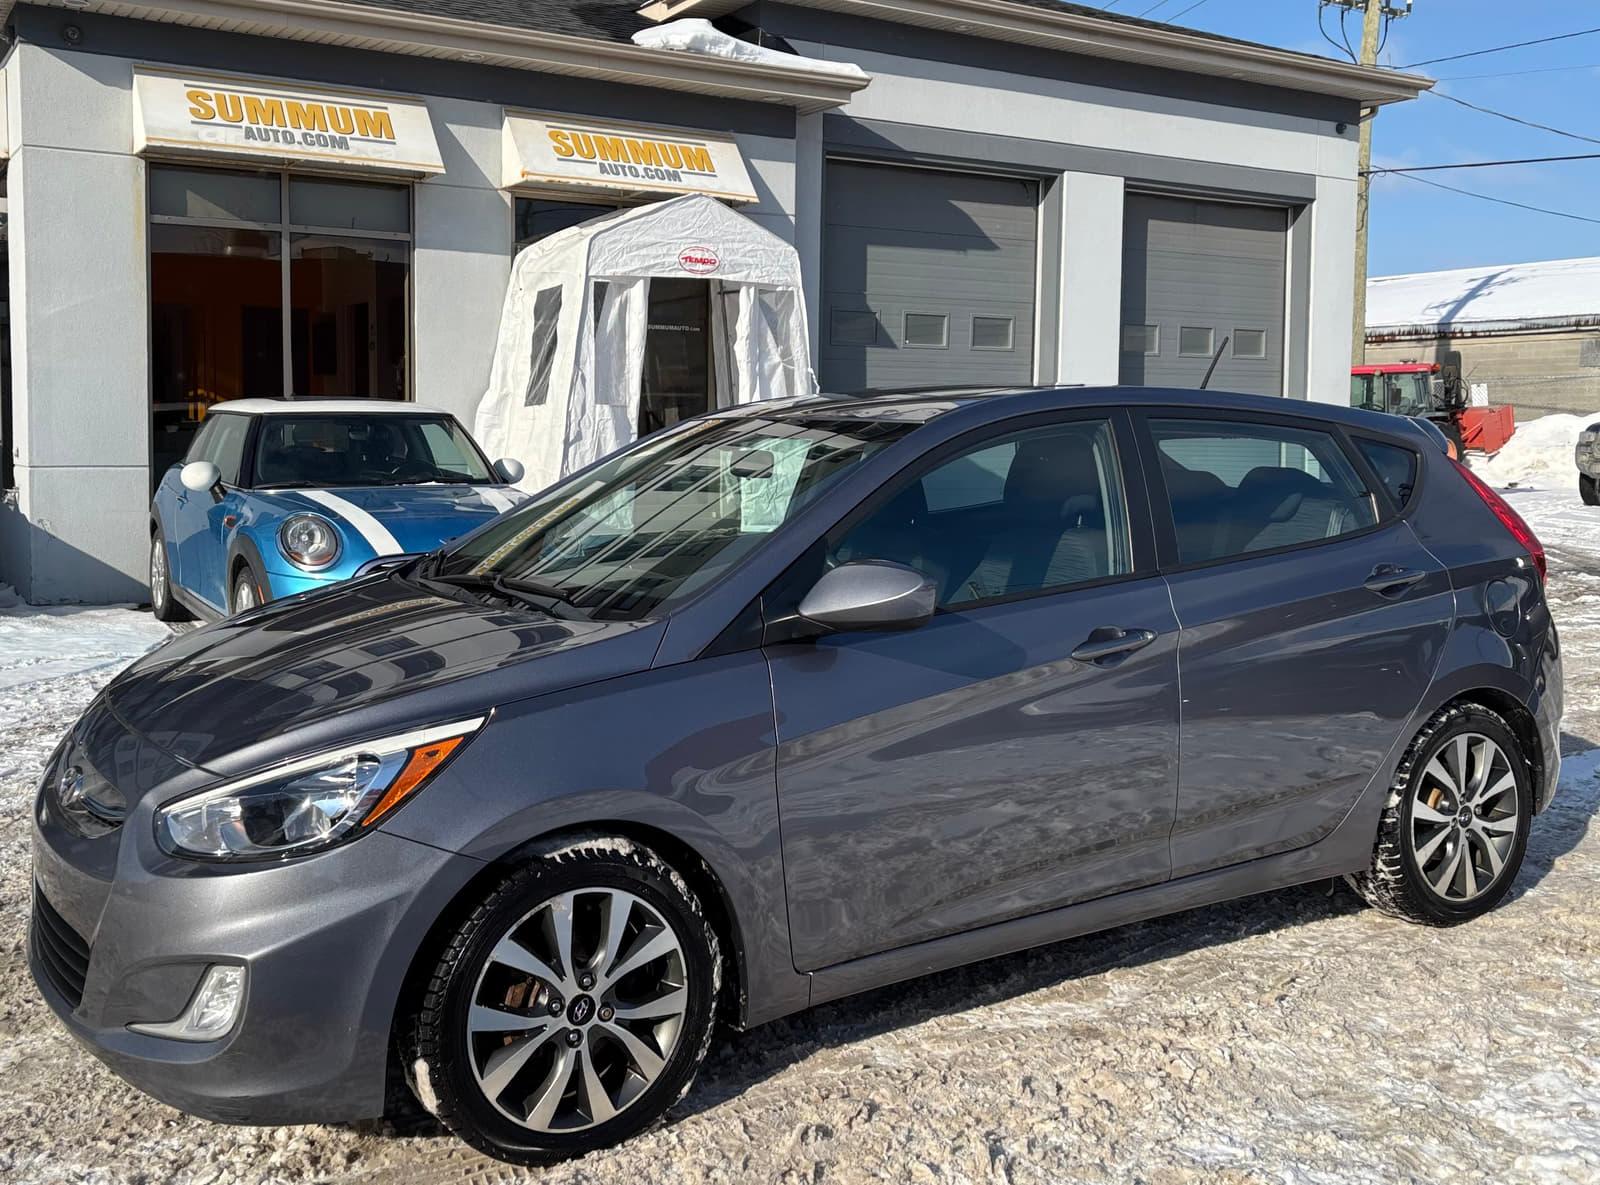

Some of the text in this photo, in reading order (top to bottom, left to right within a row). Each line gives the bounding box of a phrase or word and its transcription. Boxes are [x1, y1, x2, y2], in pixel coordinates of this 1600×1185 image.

[186, 90, 396, 140] SUMMUM
[244, 126, 350, 150] AUTO.COM
[548, 130, 716, 173] SUMMUM
[599, 163, 683, 183] AUTO.COM
[681, 255, 718, 265] TEMPO
